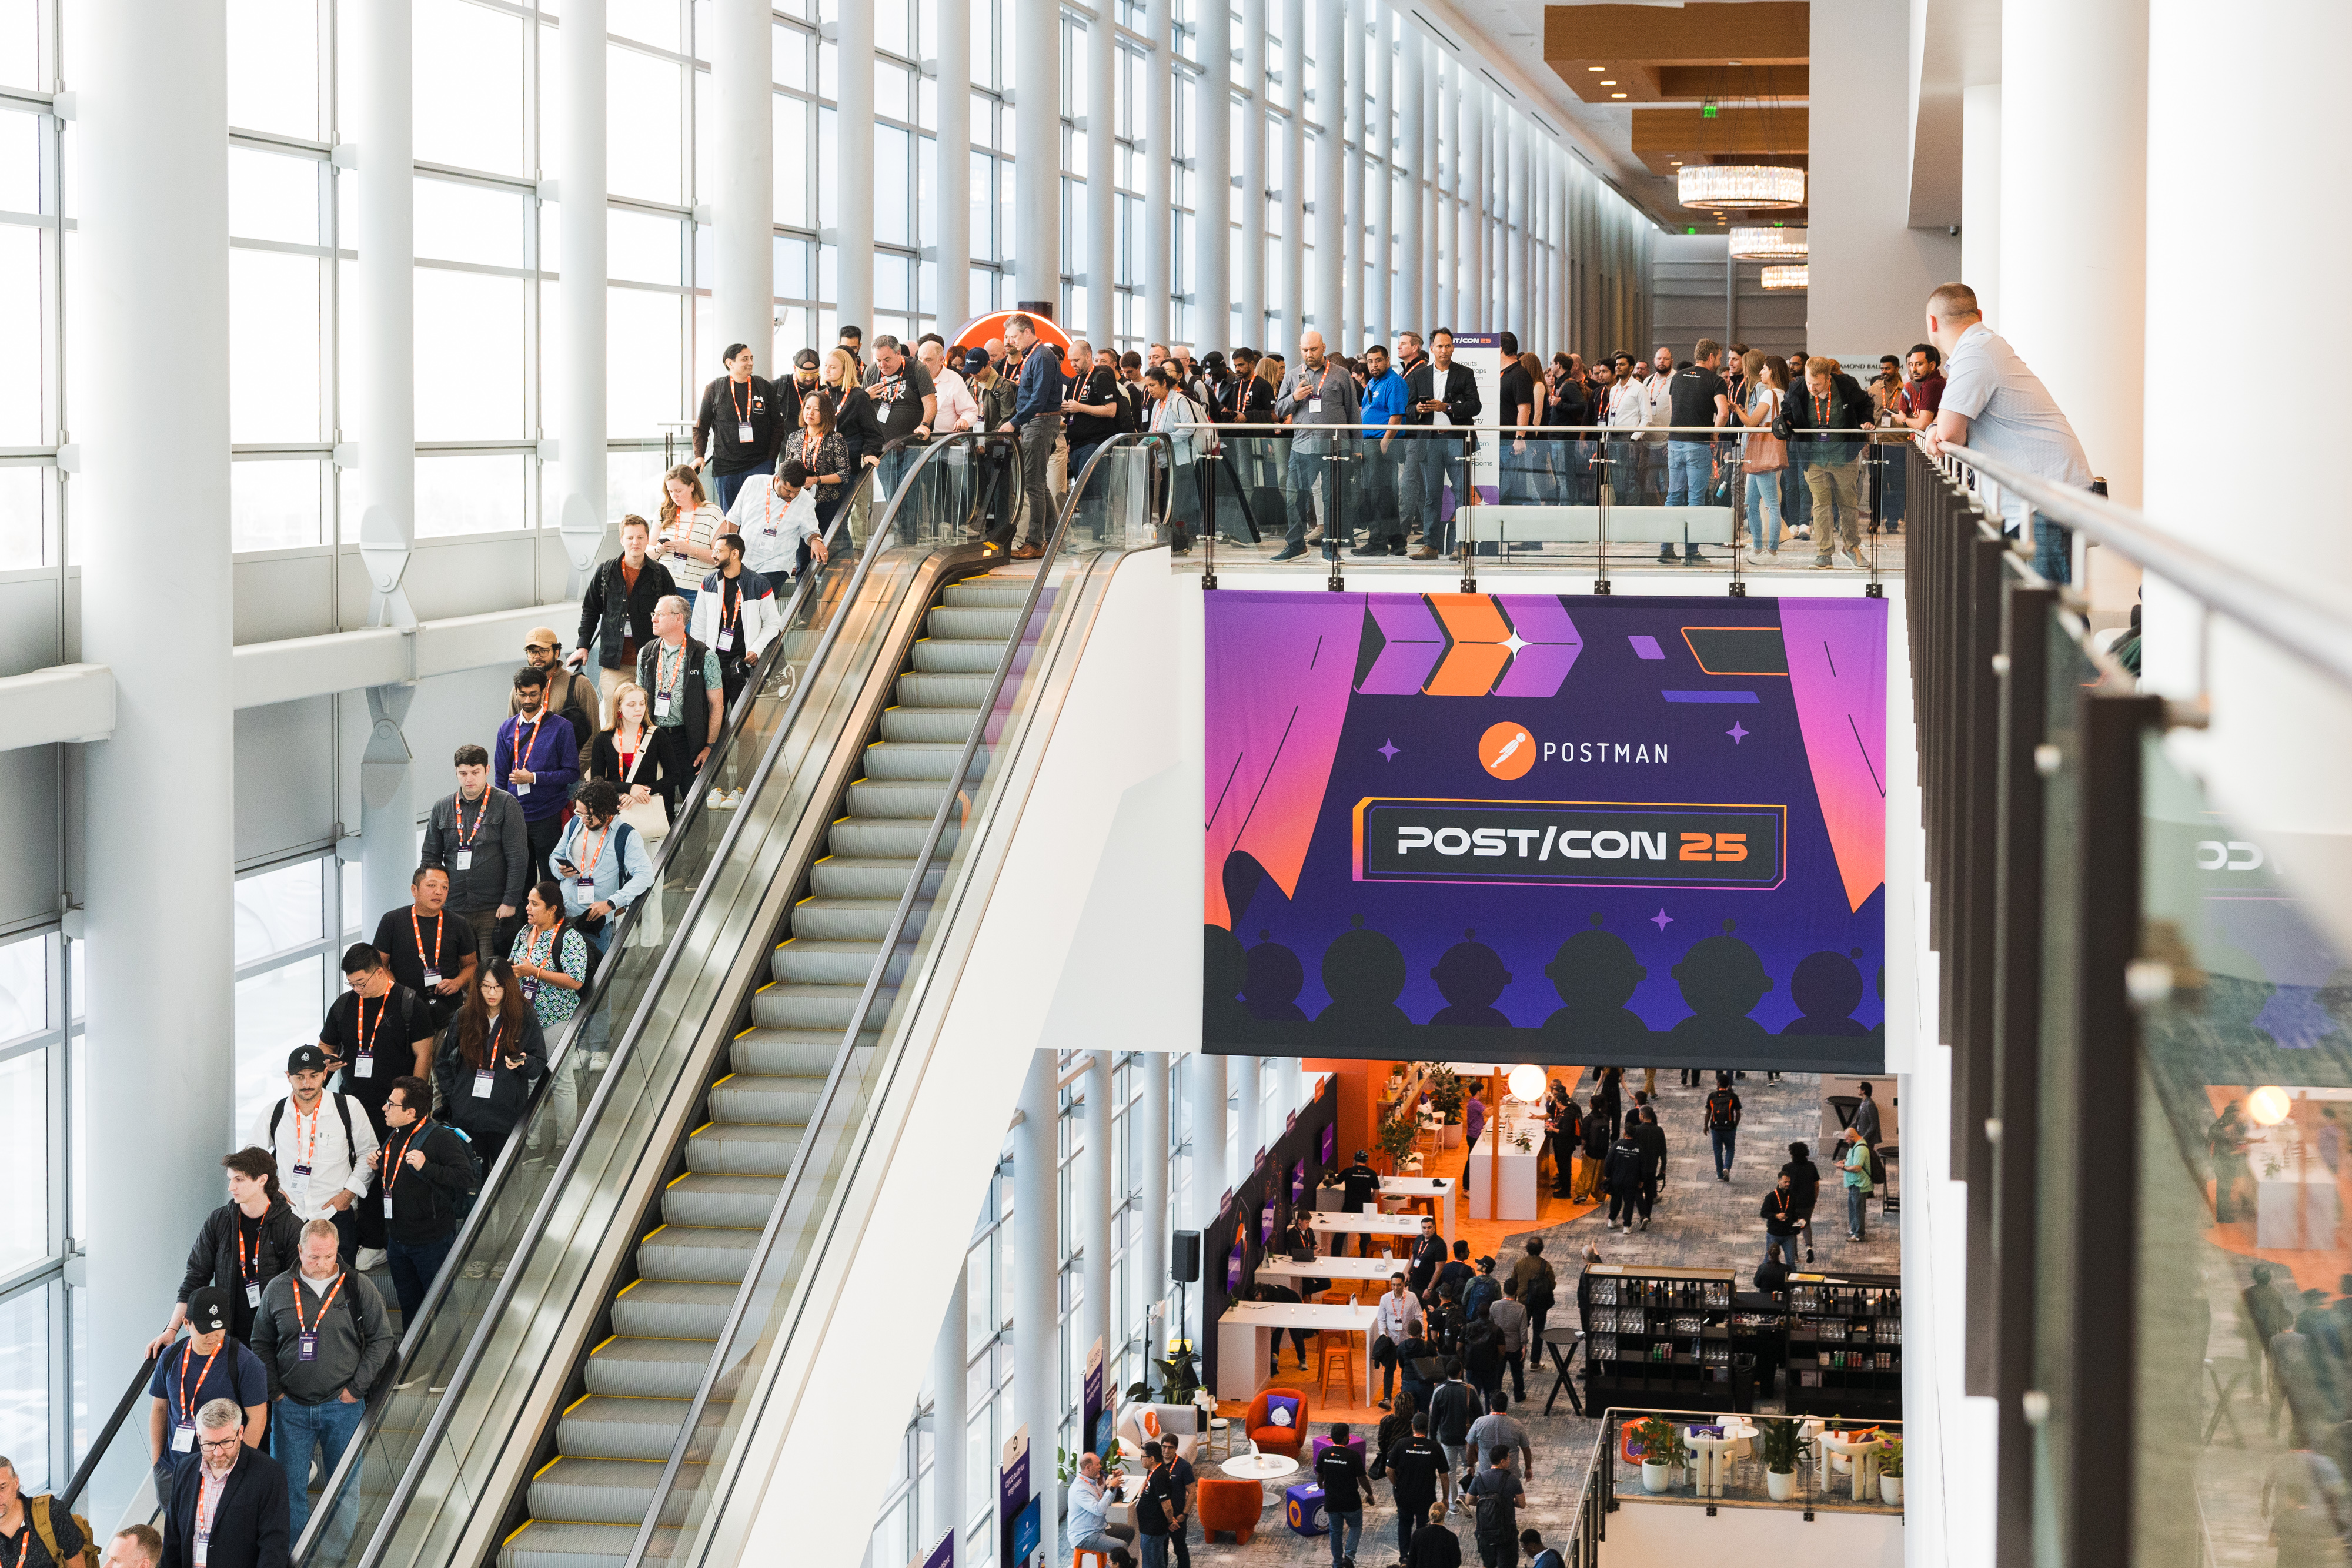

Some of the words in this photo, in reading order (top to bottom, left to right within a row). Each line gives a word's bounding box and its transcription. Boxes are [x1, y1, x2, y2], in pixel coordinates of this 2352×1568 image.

[1544, 742, 1668, 764] POSTMAN
[1398, 825, 1667, 861] POST/CON
[1679, 832, 1748, 862] 25
